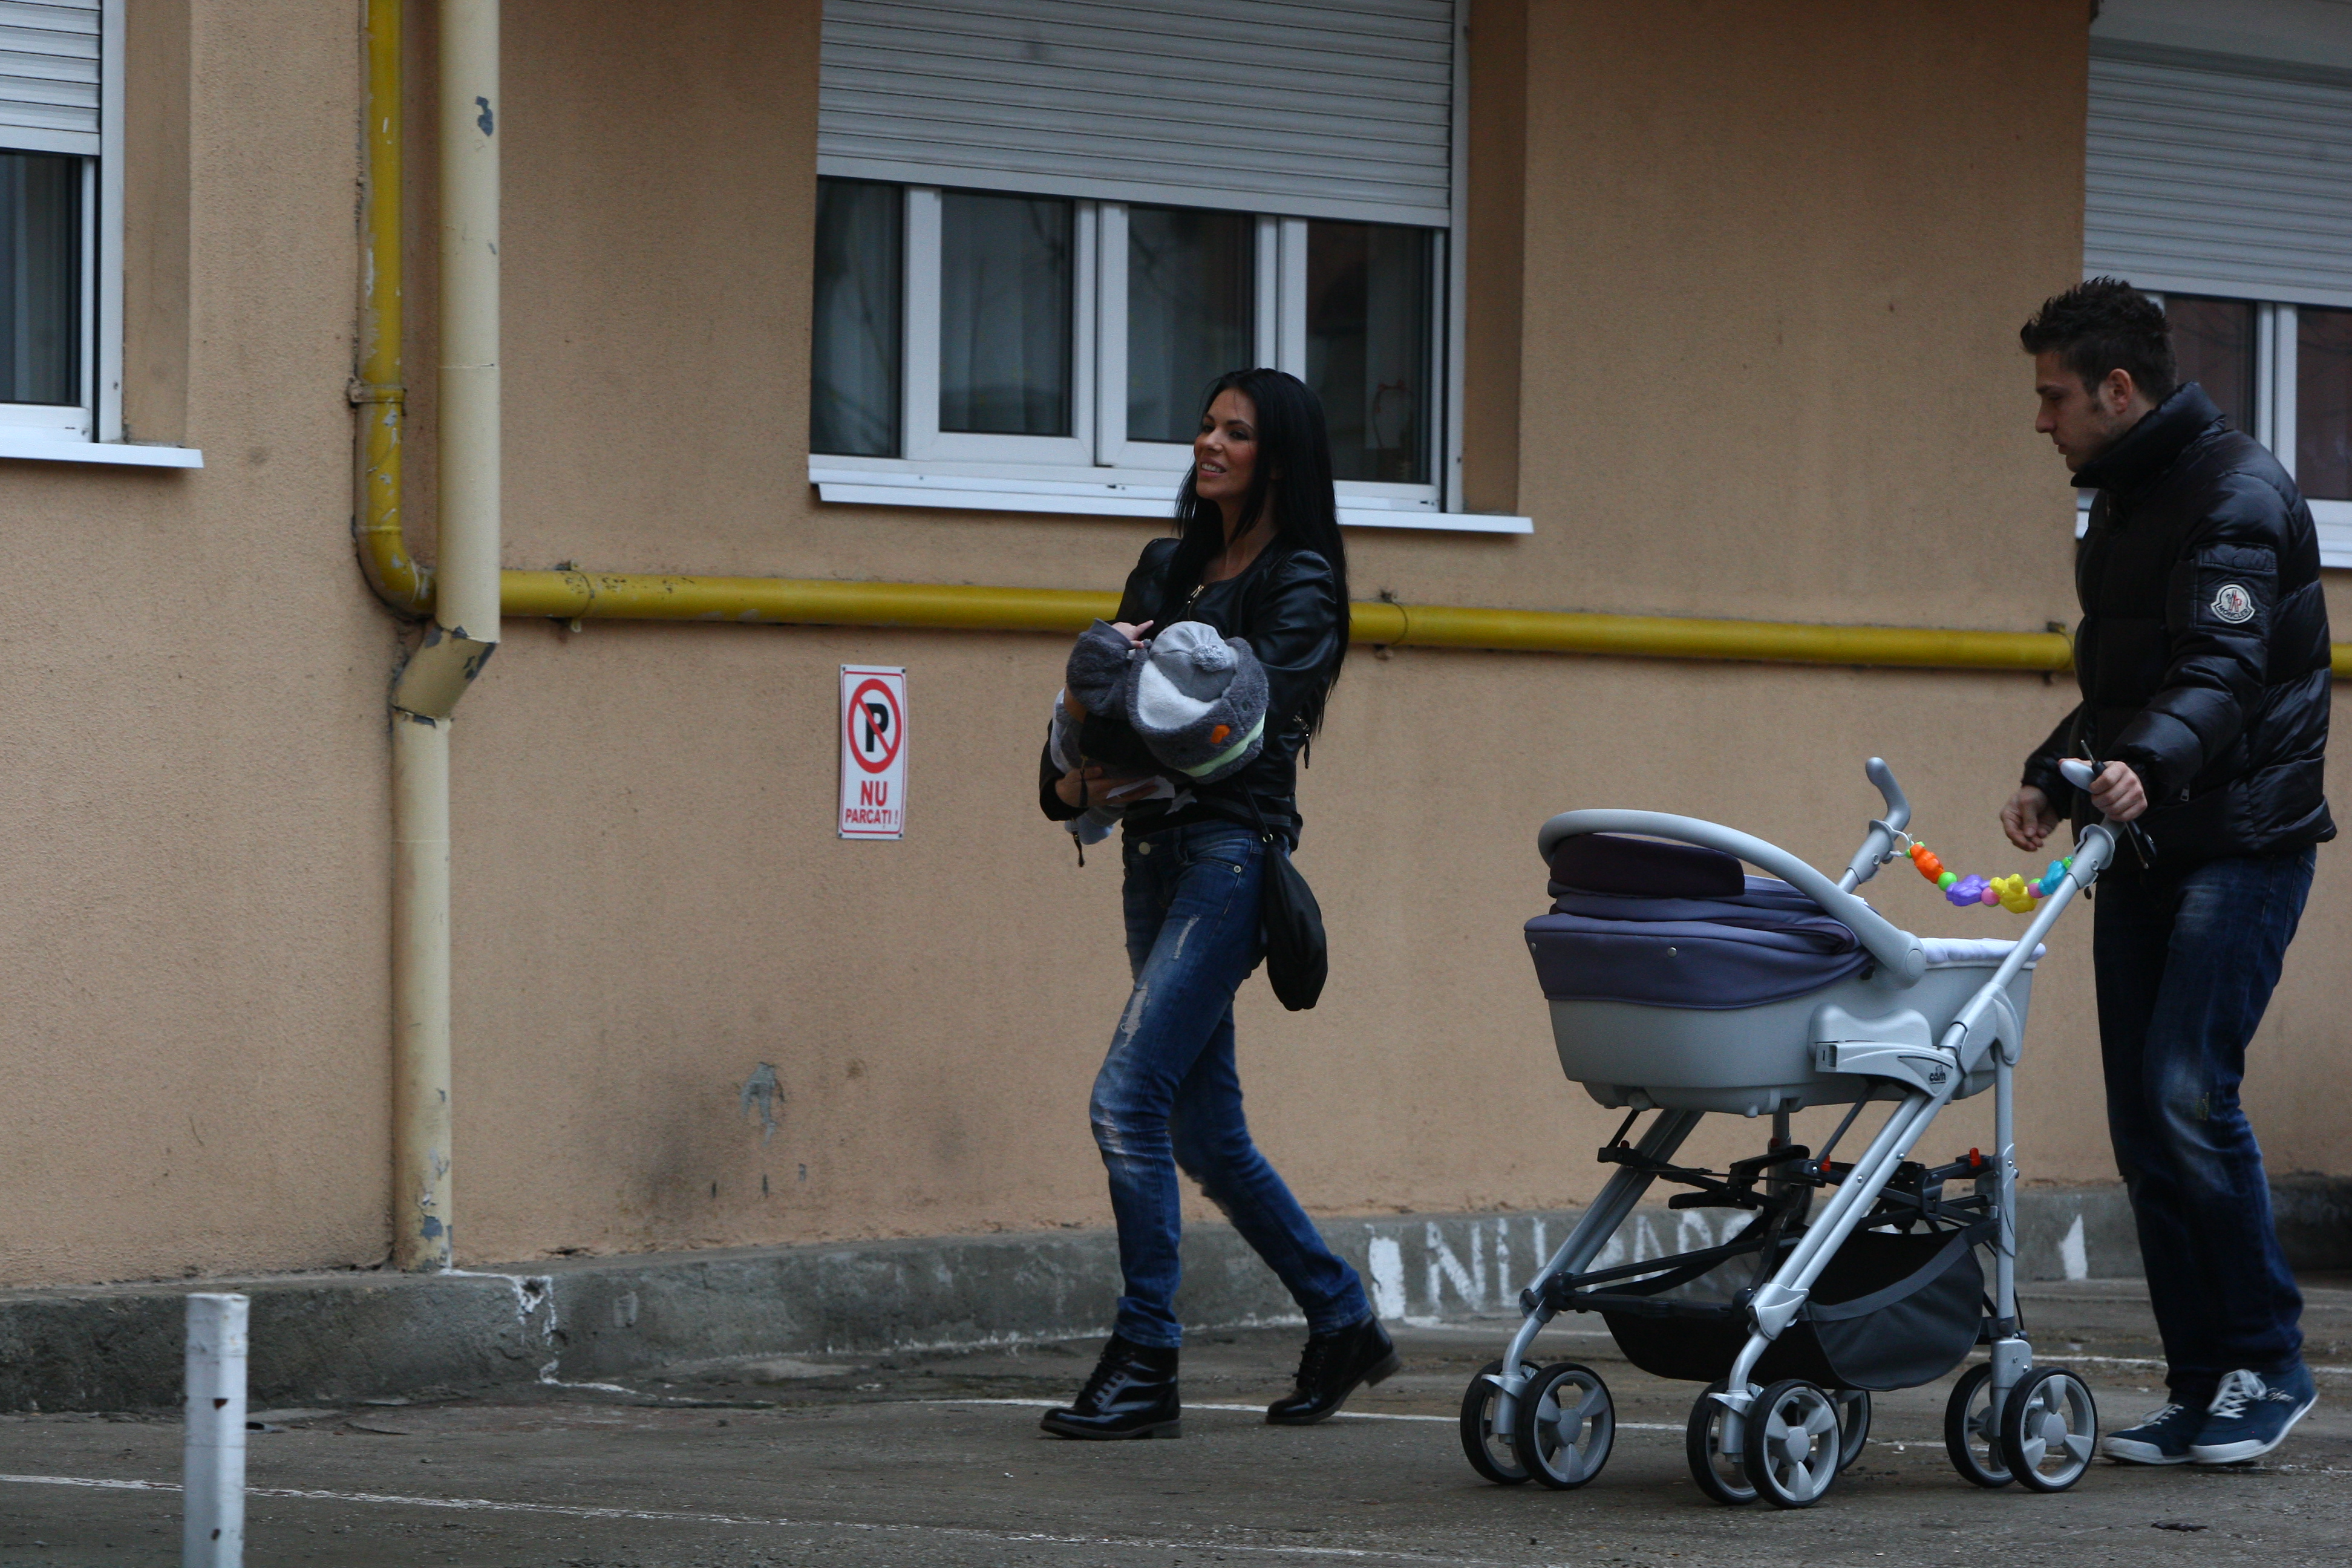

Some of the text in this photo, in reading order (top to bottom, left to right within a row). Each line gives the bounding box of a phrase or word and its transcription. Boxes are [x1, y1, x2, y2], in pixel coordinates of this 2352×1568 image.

[2218, 605, 2249, 618] MONCLER
[866, 703, 889, 752] P
[861, 780, 887, 806] NU
